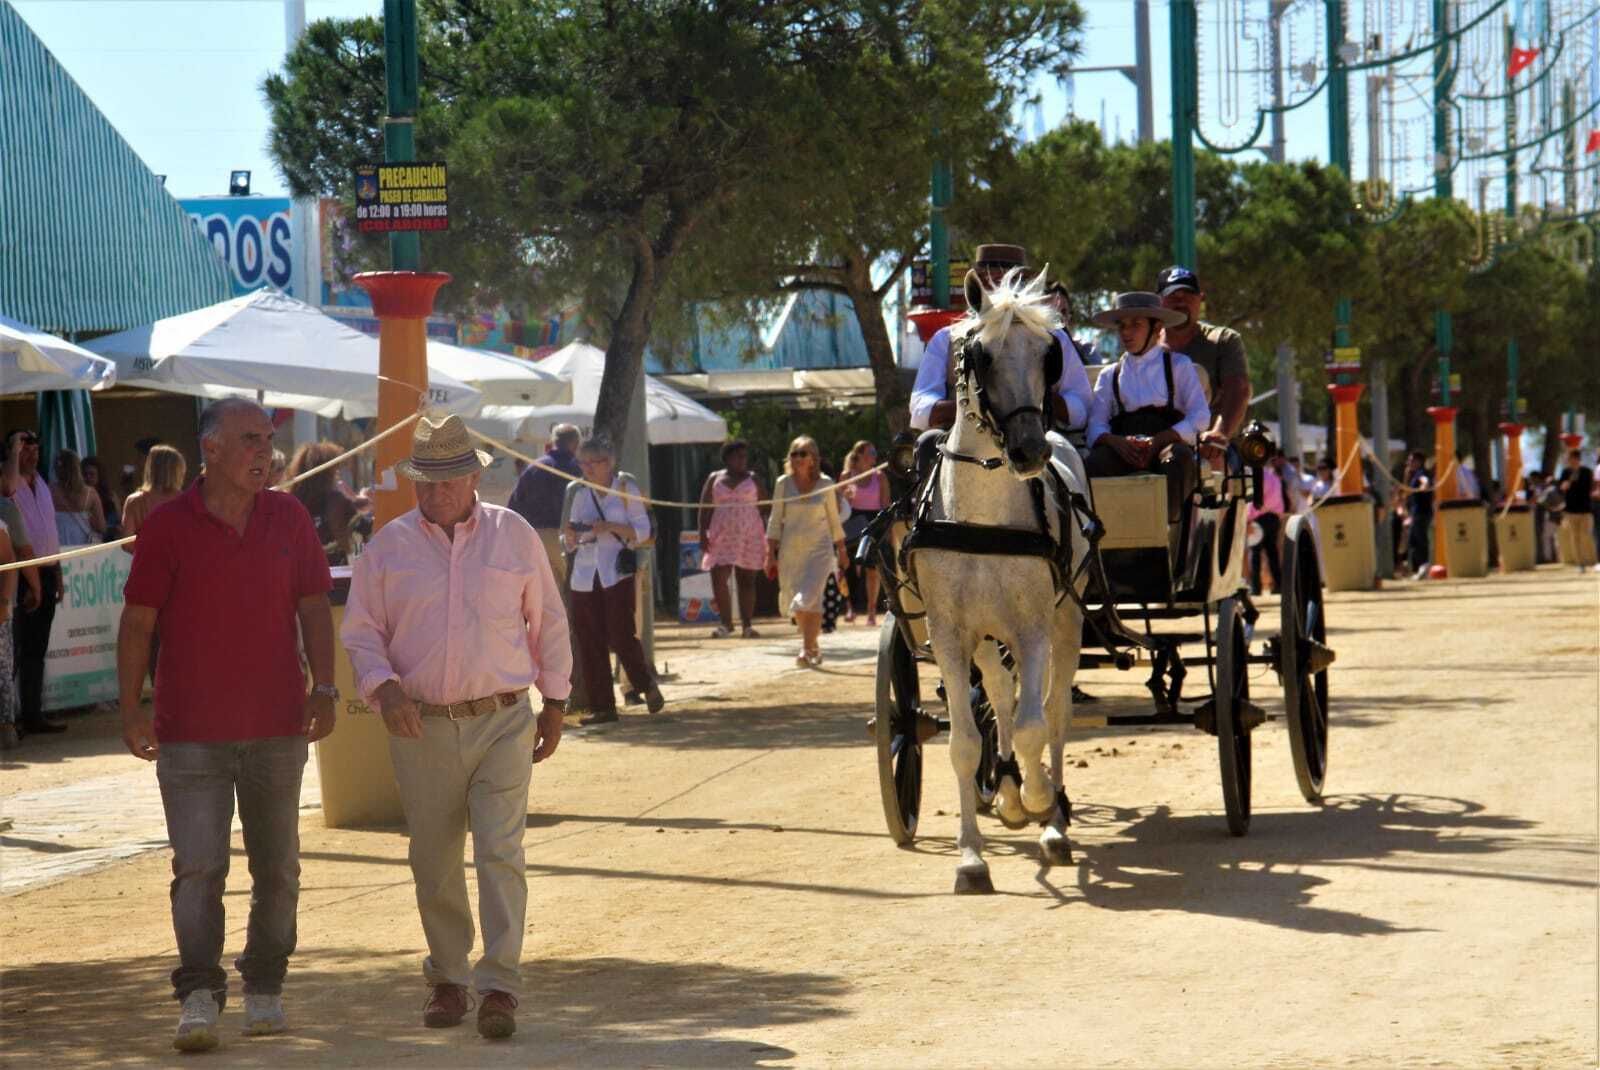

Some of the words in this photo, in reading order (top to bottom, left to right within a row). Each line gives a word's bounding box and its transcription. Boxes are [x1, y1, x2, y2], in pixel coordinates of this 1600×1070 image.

[379, 163, 446, 188] PRECAUCIÓN
[379, 190, 402, 203] PASEO
[402, 190, 412, 203] DE
[412, 188, 448, 203] CABALLOS
[357, 205, 368, 218] de
[368, 204, 391, 218] 12:00
[400, 203, 422, 217] 19:00
[423, 203, 448, 217] horas
[191, 214, 293, 288] DOS
